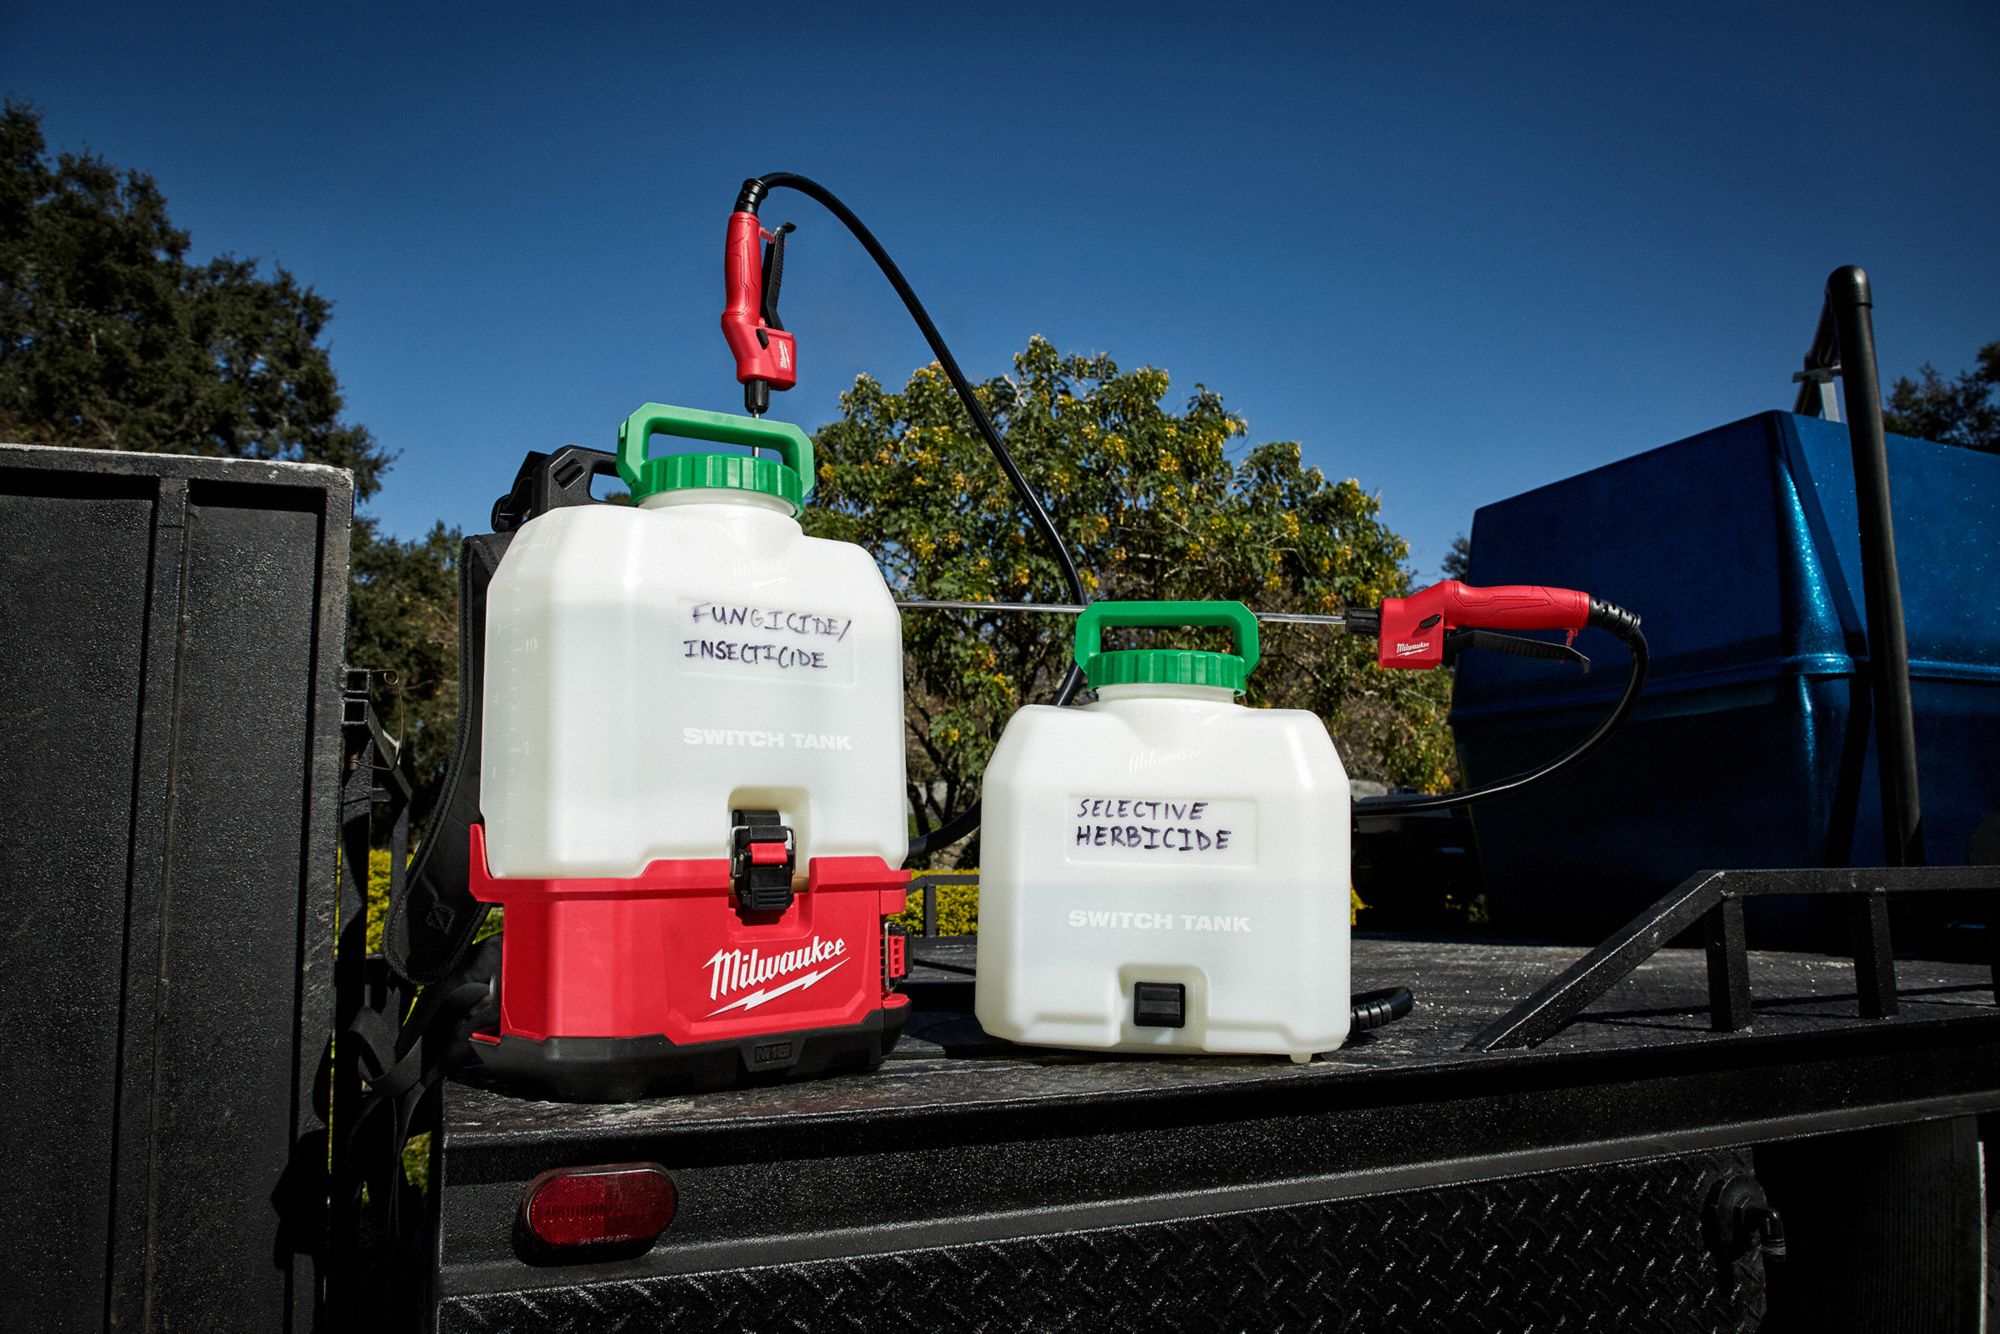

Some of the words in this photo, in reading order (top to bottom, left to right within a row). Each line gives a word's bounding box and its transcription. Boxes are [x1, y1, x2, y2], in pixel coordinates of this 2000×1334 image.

[692, 603, 852, 642] FUNGICIDE/
[683, 640, 828, 668] INSECTICIDE
[683, 728, 785, 748] SWITCH
[791, 733, 853, 750] TANK
[1077, 798, 1209, 820] SELECTIVE
[1076, 824, 1232, 851] HERBICIDE
[1068, 909, 1173, 930] SWITCH
[1180, 914, 1252, 932] TANK
[702, 936, 847, 1001] Milwaukee
